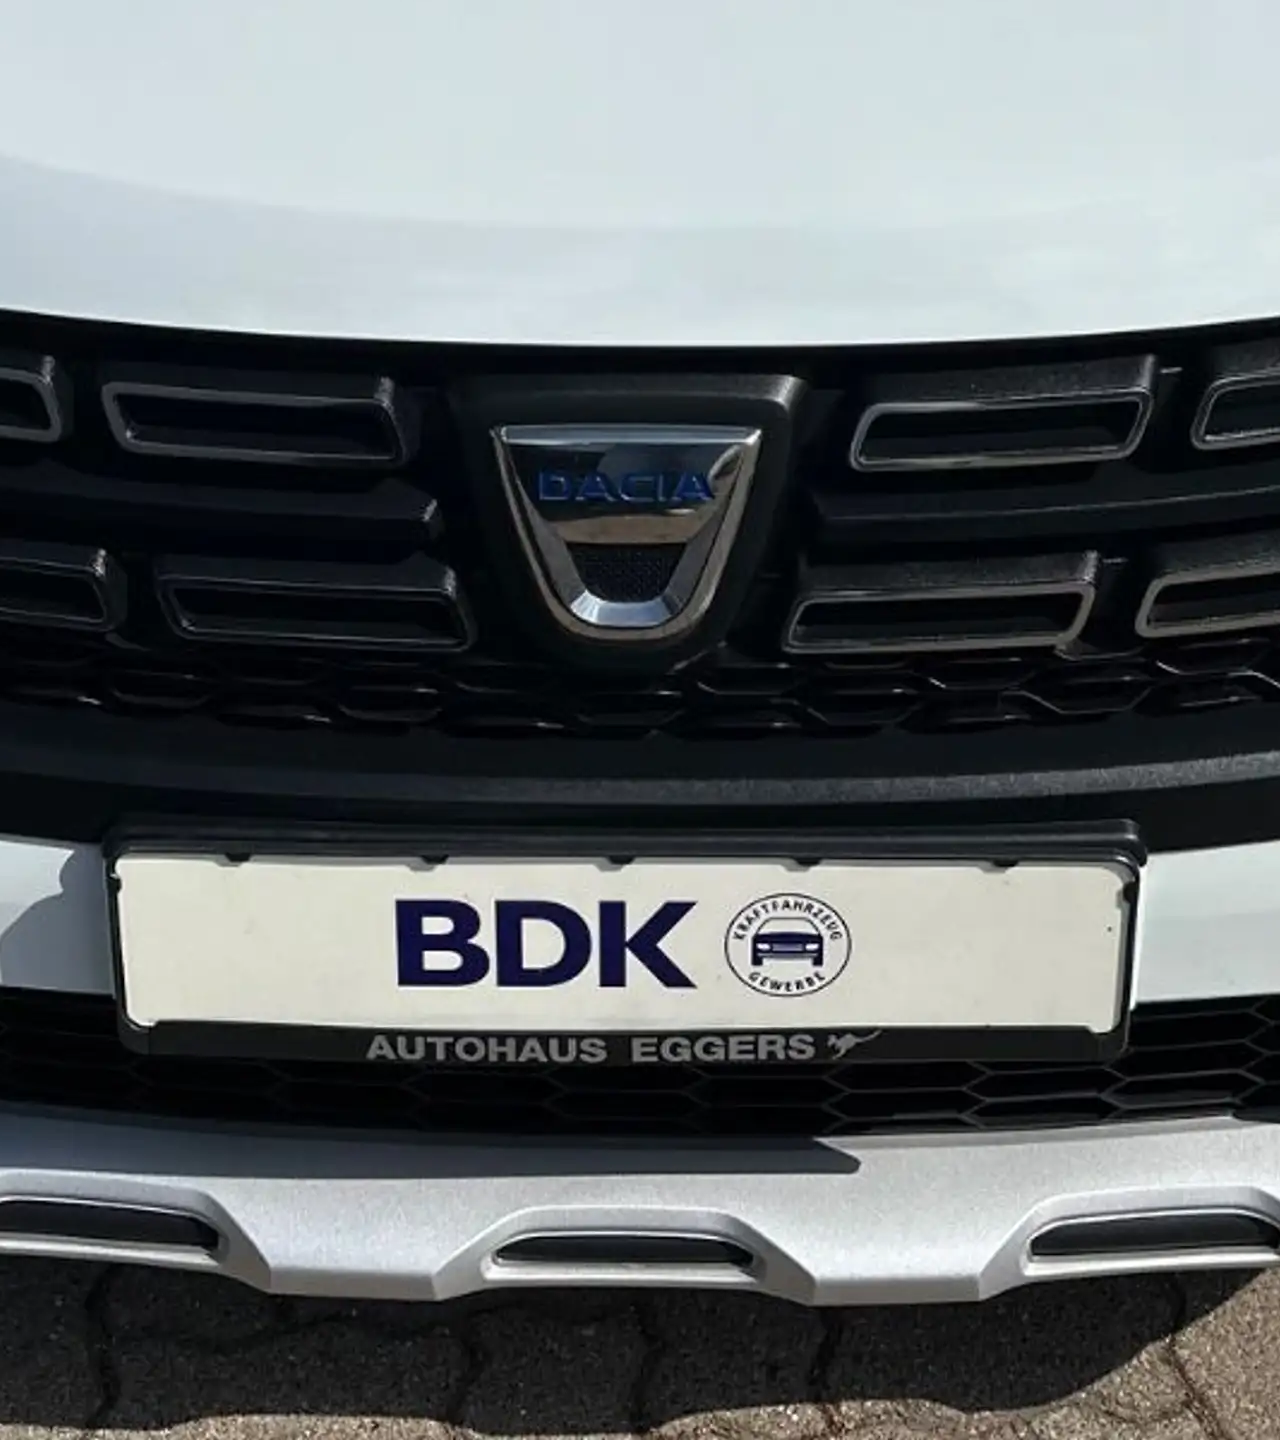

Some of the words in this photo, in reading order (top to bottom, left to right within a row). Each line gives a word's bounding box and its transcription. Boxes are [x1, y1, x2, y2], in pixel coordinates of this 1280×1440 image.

[538, 471, 715, 502] DACIA
[732, 900, 843, 941] KRAFTFAHRZEUG
[396, 900, 698, 988] BDK
[748, 971, 826, 992] GEWERBE
[365, 1035, 608, 1064] AUTOHAUS
[631, 1034, 816, 1062] EGGERS
